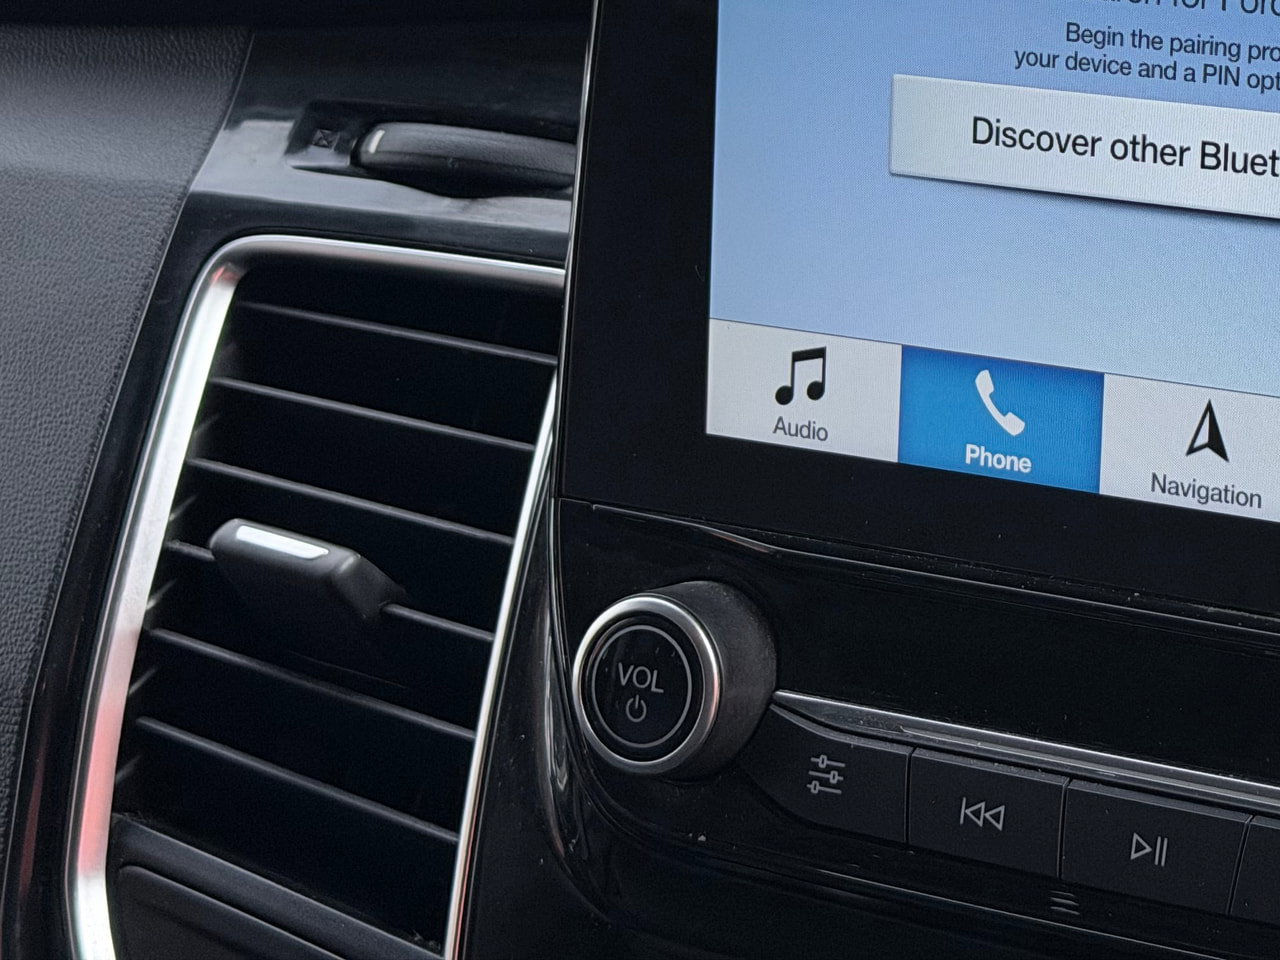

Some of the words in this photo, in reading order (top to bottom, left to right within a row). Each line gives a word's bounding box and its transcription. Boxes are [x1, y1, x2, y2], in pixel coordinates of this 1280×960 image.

[1066, 22, 1124, 49] Begin
[1130, 28, 1163, 50] the
[1169, 34, 1241, 62] pairing
[1014, 50, 1060, 69] your
[1065, 51, 1132, 76] device
[1138, 60, 1177, 81] and
[1183, 66, 1196, 82] a
[1202, 63, 1241, 87] PIN
[972, 116, 1102, 157] Discover
[1110, 134, 1191, 167] other
[772, 415, 828, 442] Audio
[965, 443, 1032, 474] Phone
[1150, 472, 1262, 509] Navigation
[618, 662, 664, 693] VOL
